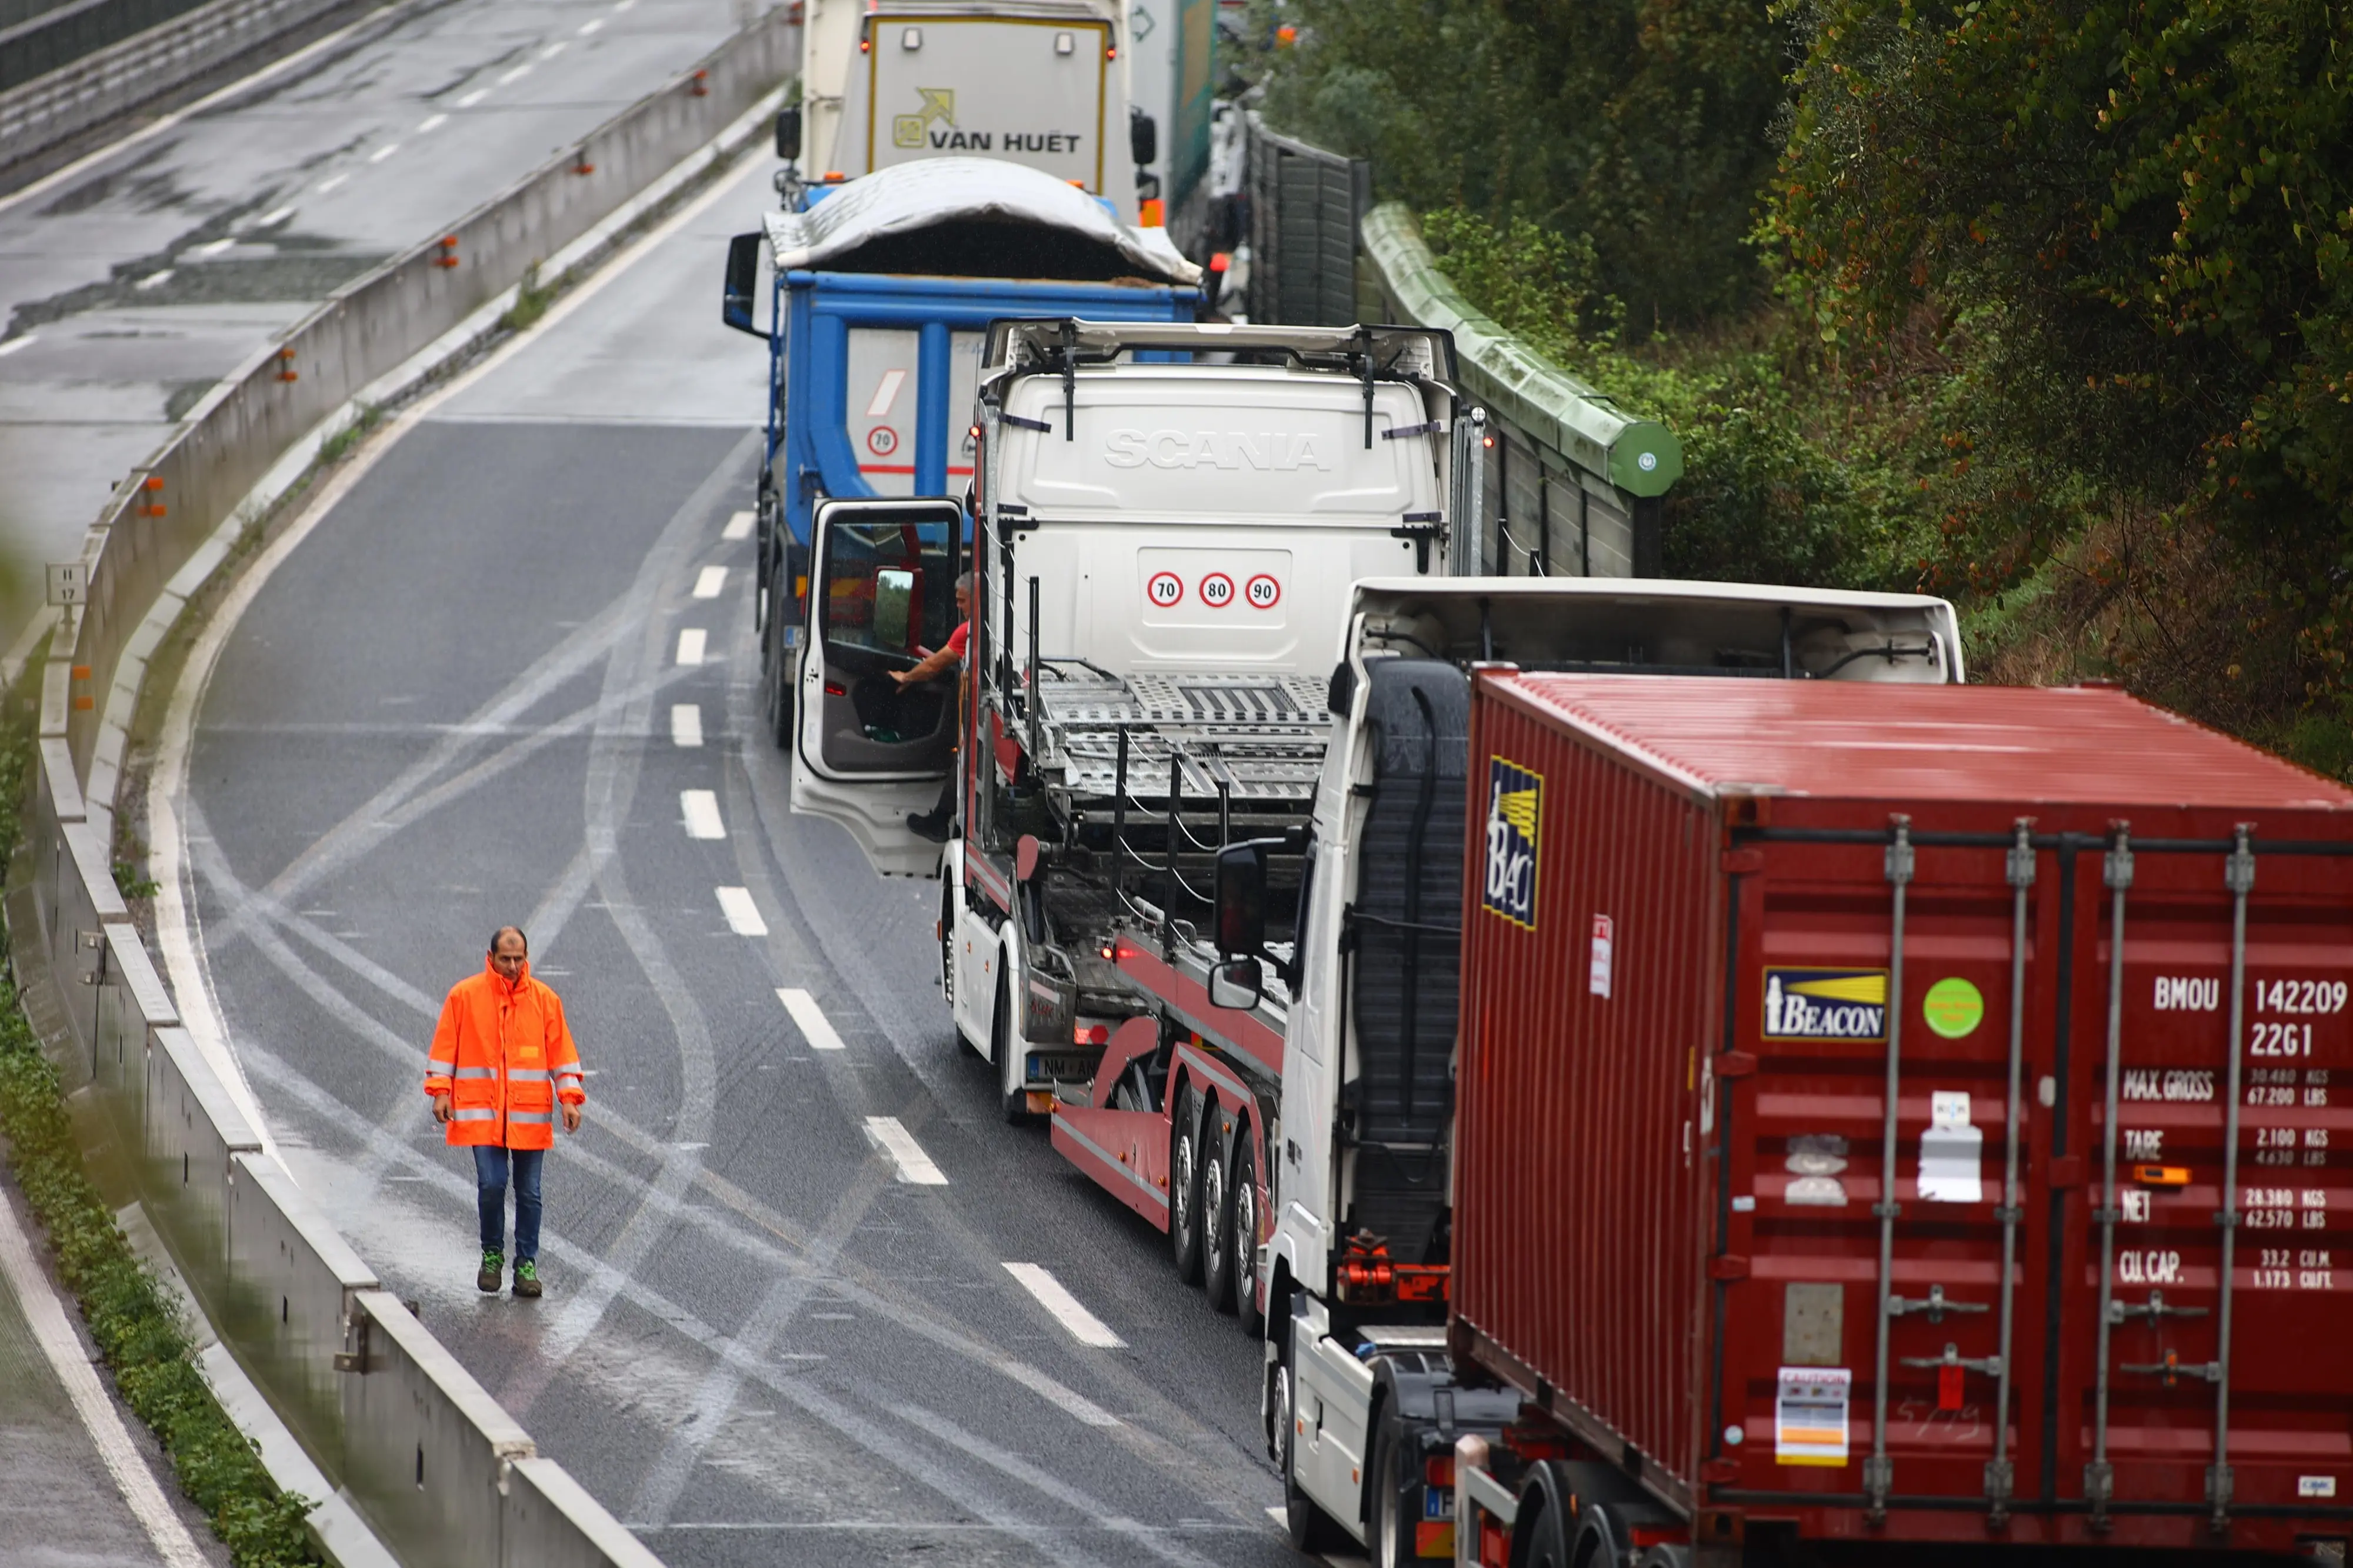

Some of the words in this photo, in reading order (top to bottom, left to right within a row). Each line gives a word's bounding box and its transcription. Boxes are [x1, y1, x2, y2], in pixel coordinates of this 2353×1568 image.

[929, 131, 992, 151] VAN
[875, 433, 891, 446] 70
[1104, 429, 1331, 472] SCANIA
[61, 588, 75, 600] 17
[1158, 583, 1175, 597] 70
[1208, 583, 1226, 598] 80
[1254, 584, 1272, 599] 90
[2154, 976, 2219, 1011] BMOU
[2255, 979, 2348, 1014] 142209
[1781, 994, 1885, 1036] BEACON
[2250, 1022, 2312, 1057] 22G1
[1044, 1059, 1065, 1075] NM
[2305, 1068, 2329, 1085] KGS
[2247, 1086, 2295, 1106] 67.200
[2303, 1087, 2328, 1106] LBS
[2124, 1129, 2164, 1162] TARE
[2256, 1127, 2296, 1148] 2.100
[2304, 1128, 2329, 1148] KGS
[2302, 1150, 2327, 1166] LBS
[2121, 1189, 2151, 1223] NET
[2302, 1188, 2327, 1208] KGS
[2245, 1209, 2294, 1229] 62.570
[2302, 1209, 2327, 1229] LBS
[2261, 1248, 2291, 1267] 33.2
[2252, 1269, 2291, 1289] 1.173
